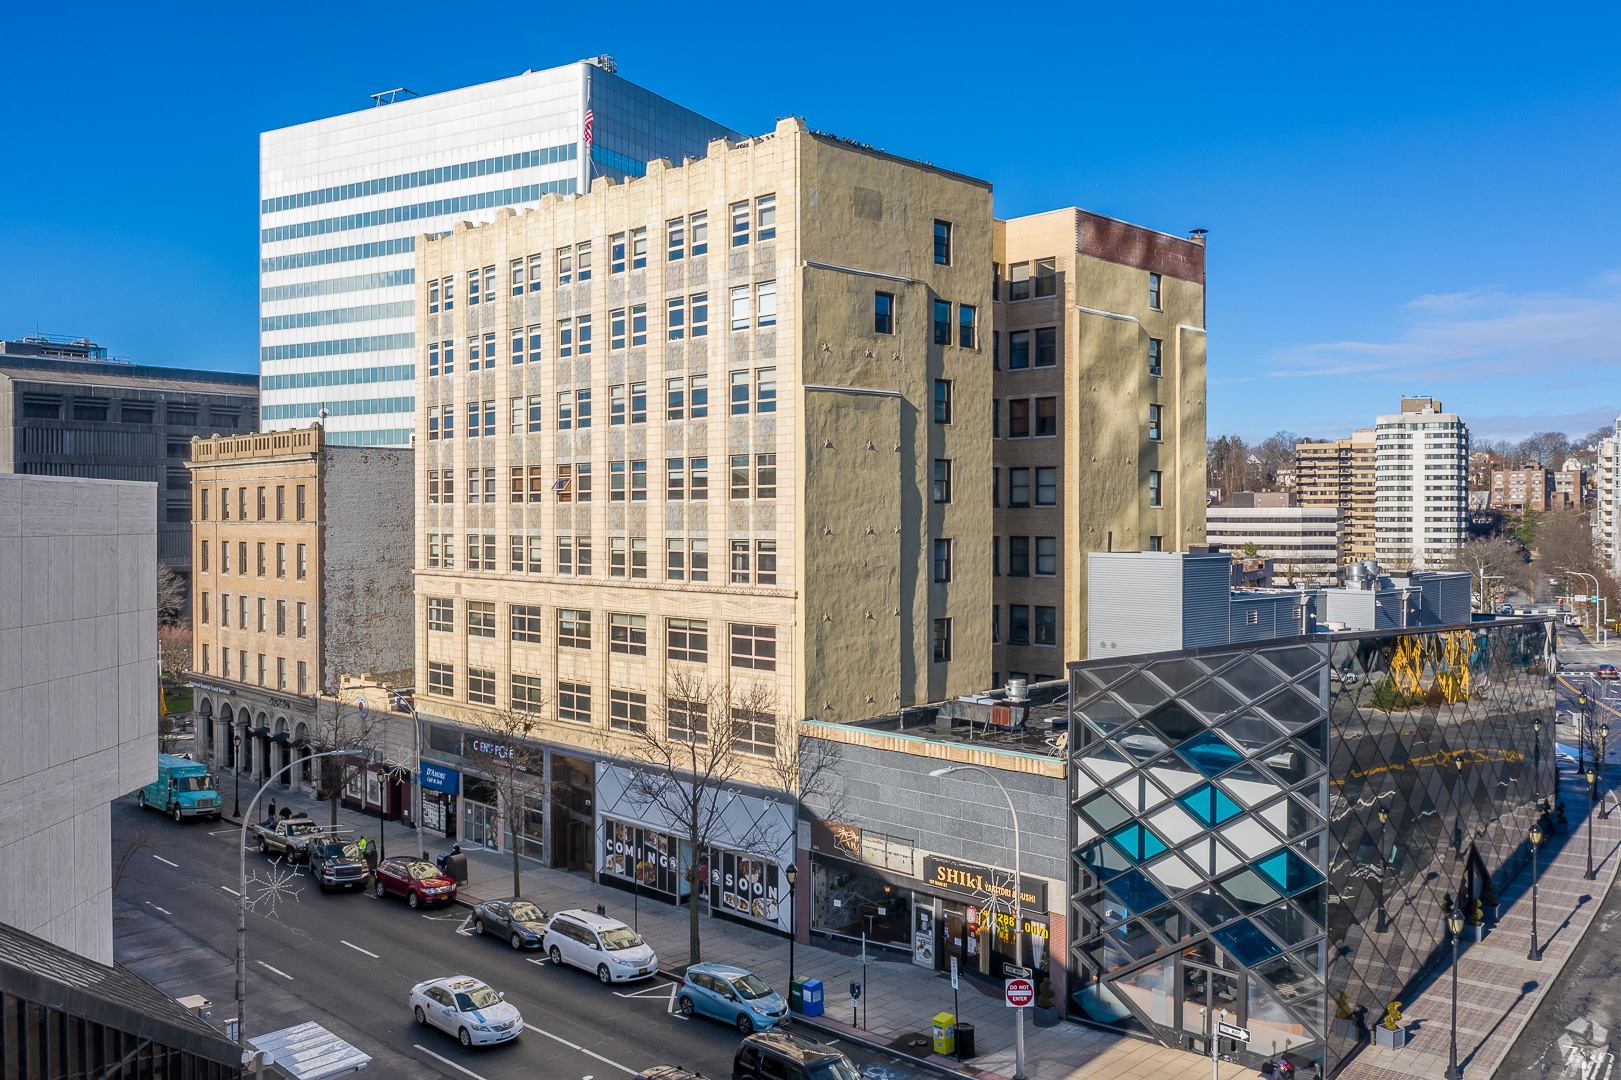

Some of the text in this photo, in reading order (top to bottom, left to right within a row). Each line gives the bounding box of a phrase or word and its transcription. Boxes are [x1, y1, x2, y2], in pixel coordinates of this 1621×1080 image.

[606, 839, 778, 900] COMING SOON
[998, 913, 1015, 927] 288
[1024, 922, 1049, 939] 0070
